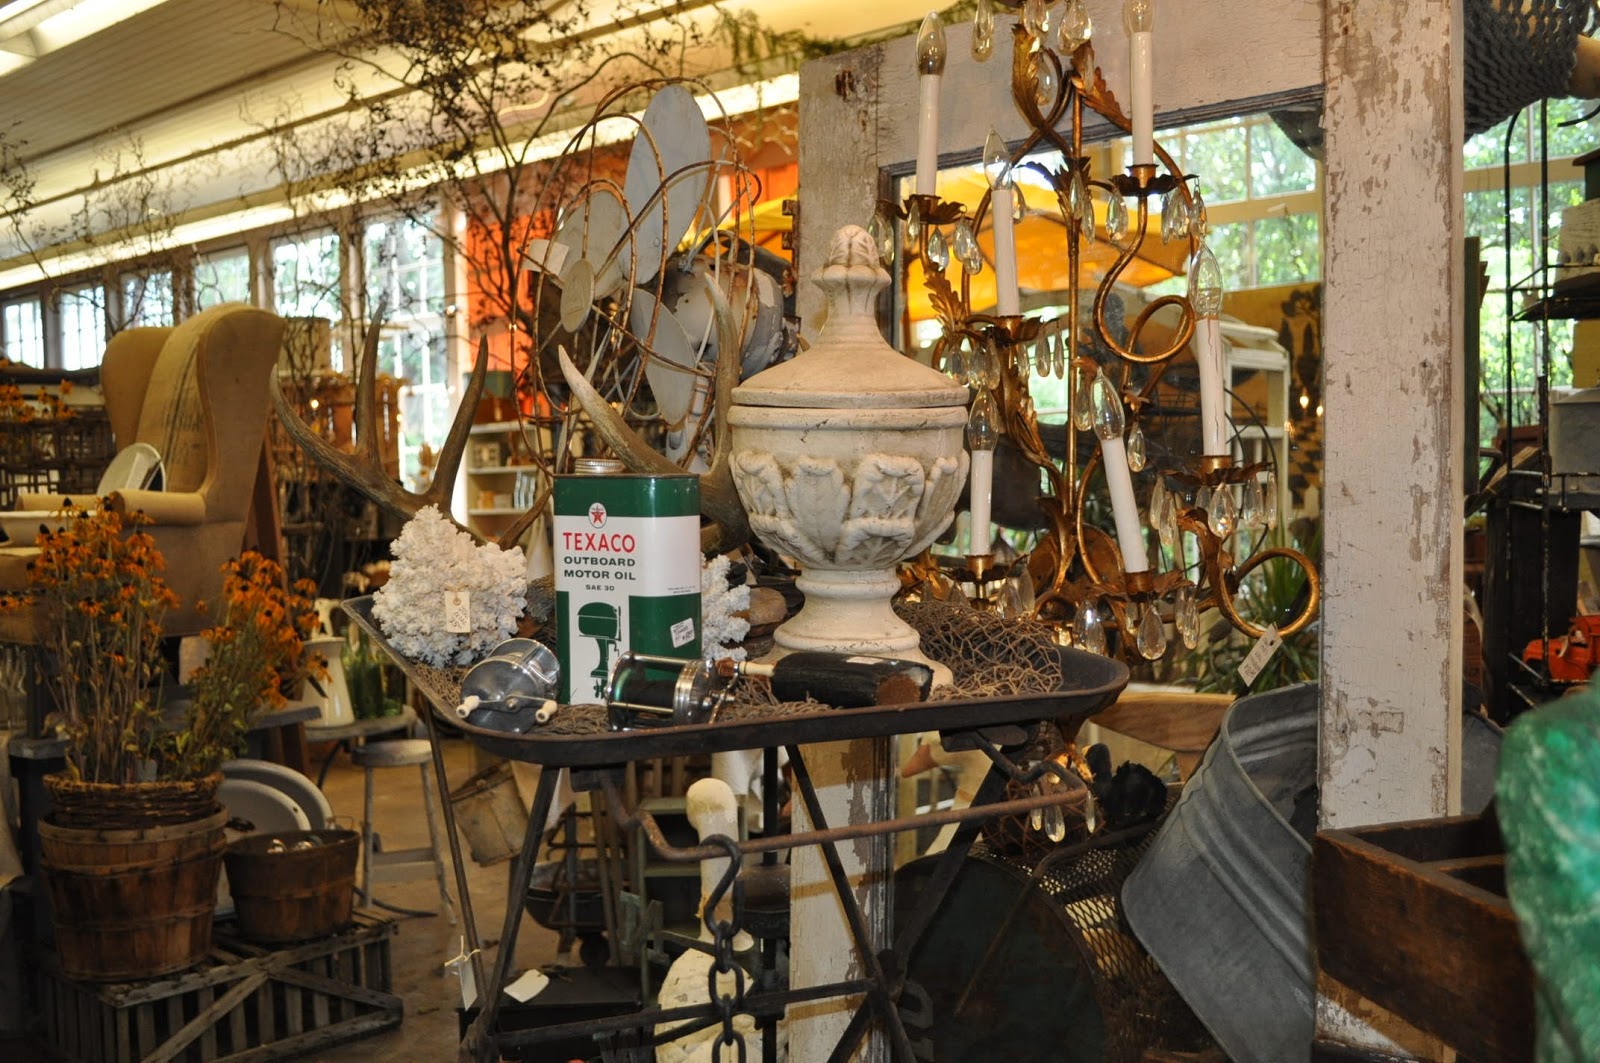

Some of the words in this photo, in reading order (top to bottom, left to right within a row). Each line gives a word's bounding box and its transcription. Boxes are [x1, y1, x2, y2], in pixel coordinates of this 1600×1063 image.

[563, 532, 636, 553] TEXACO
[563, 556, 636, 567] OUTBOARD
[564, 569, 610, 579] MOTOR
[614, 571, 636, 581] OIL
